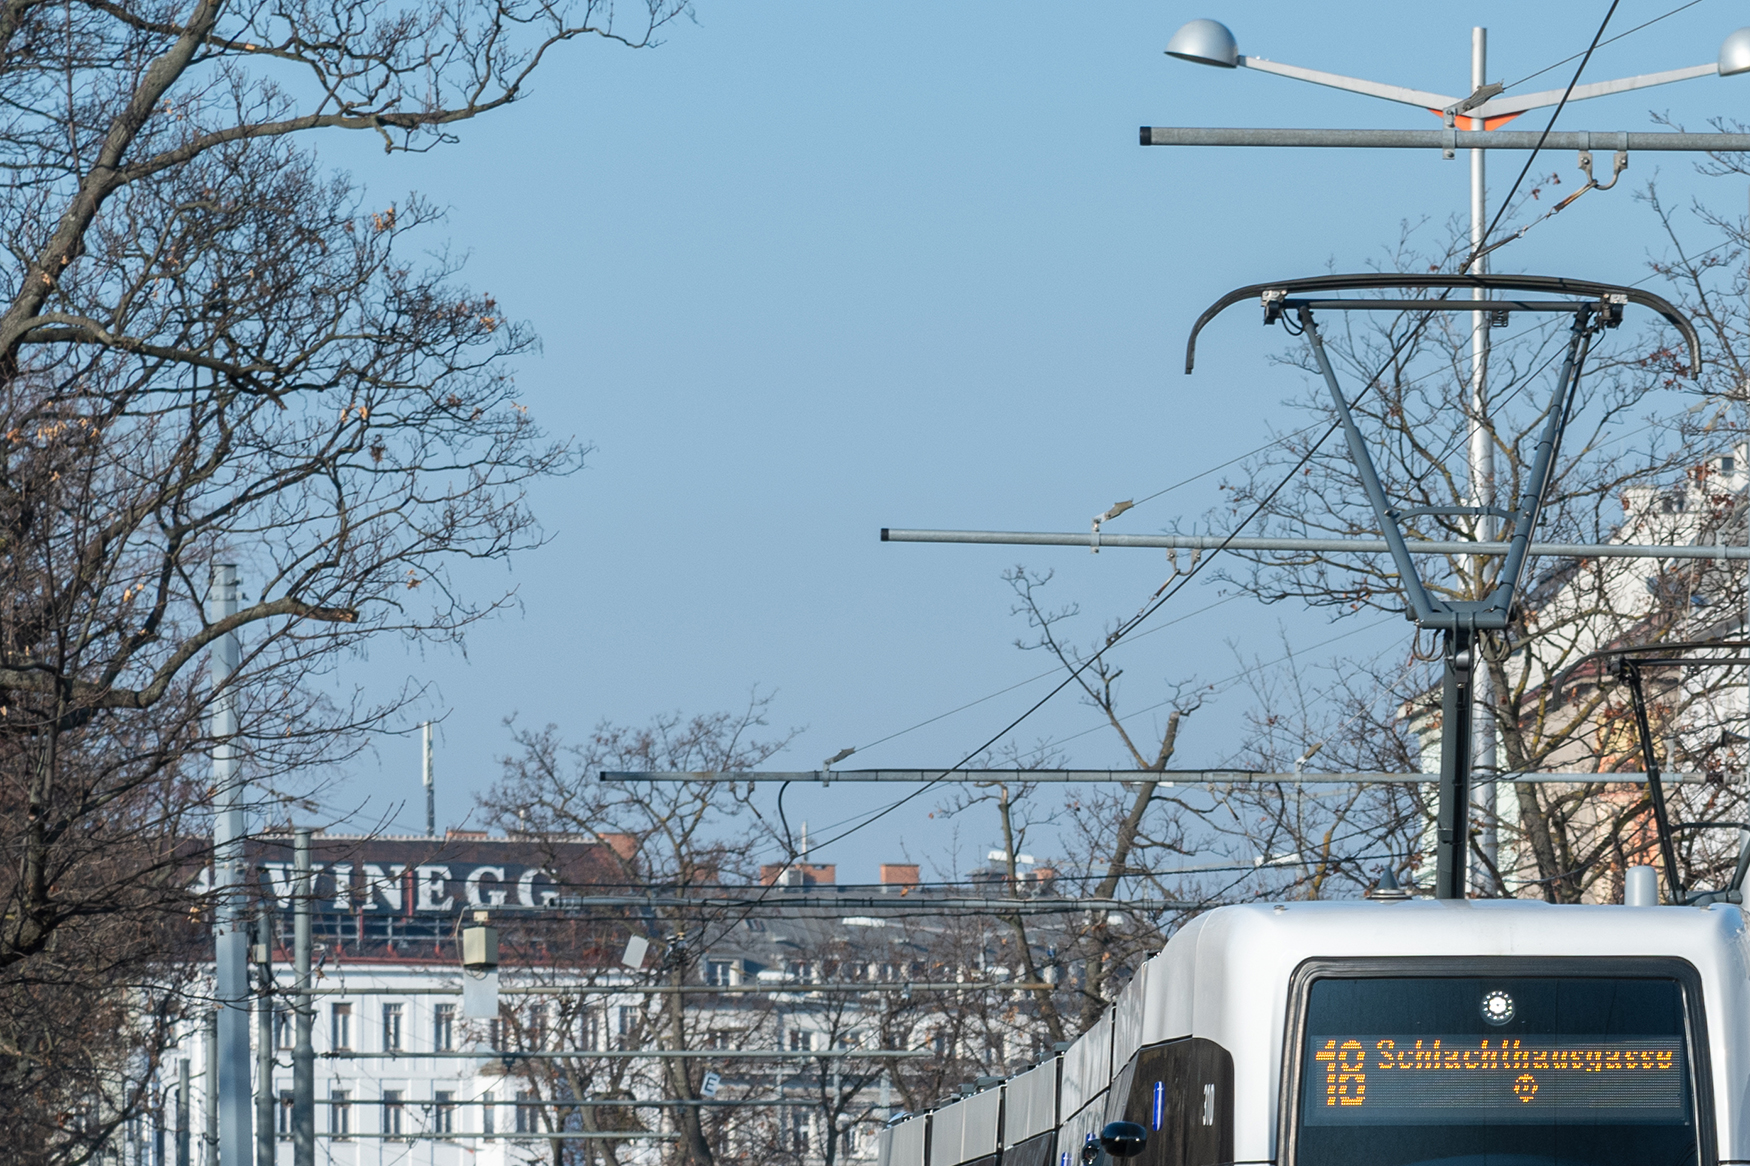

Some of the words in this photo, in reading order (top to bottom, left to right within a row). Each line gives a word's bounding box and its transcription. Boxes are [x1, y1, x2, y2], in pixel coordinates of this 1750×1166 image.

[264, 863, 560, 910] WINEGG
[1376, 1039, 1673, 1072] Schlachthausgasse
[704, 1077, 717, 1093] E
